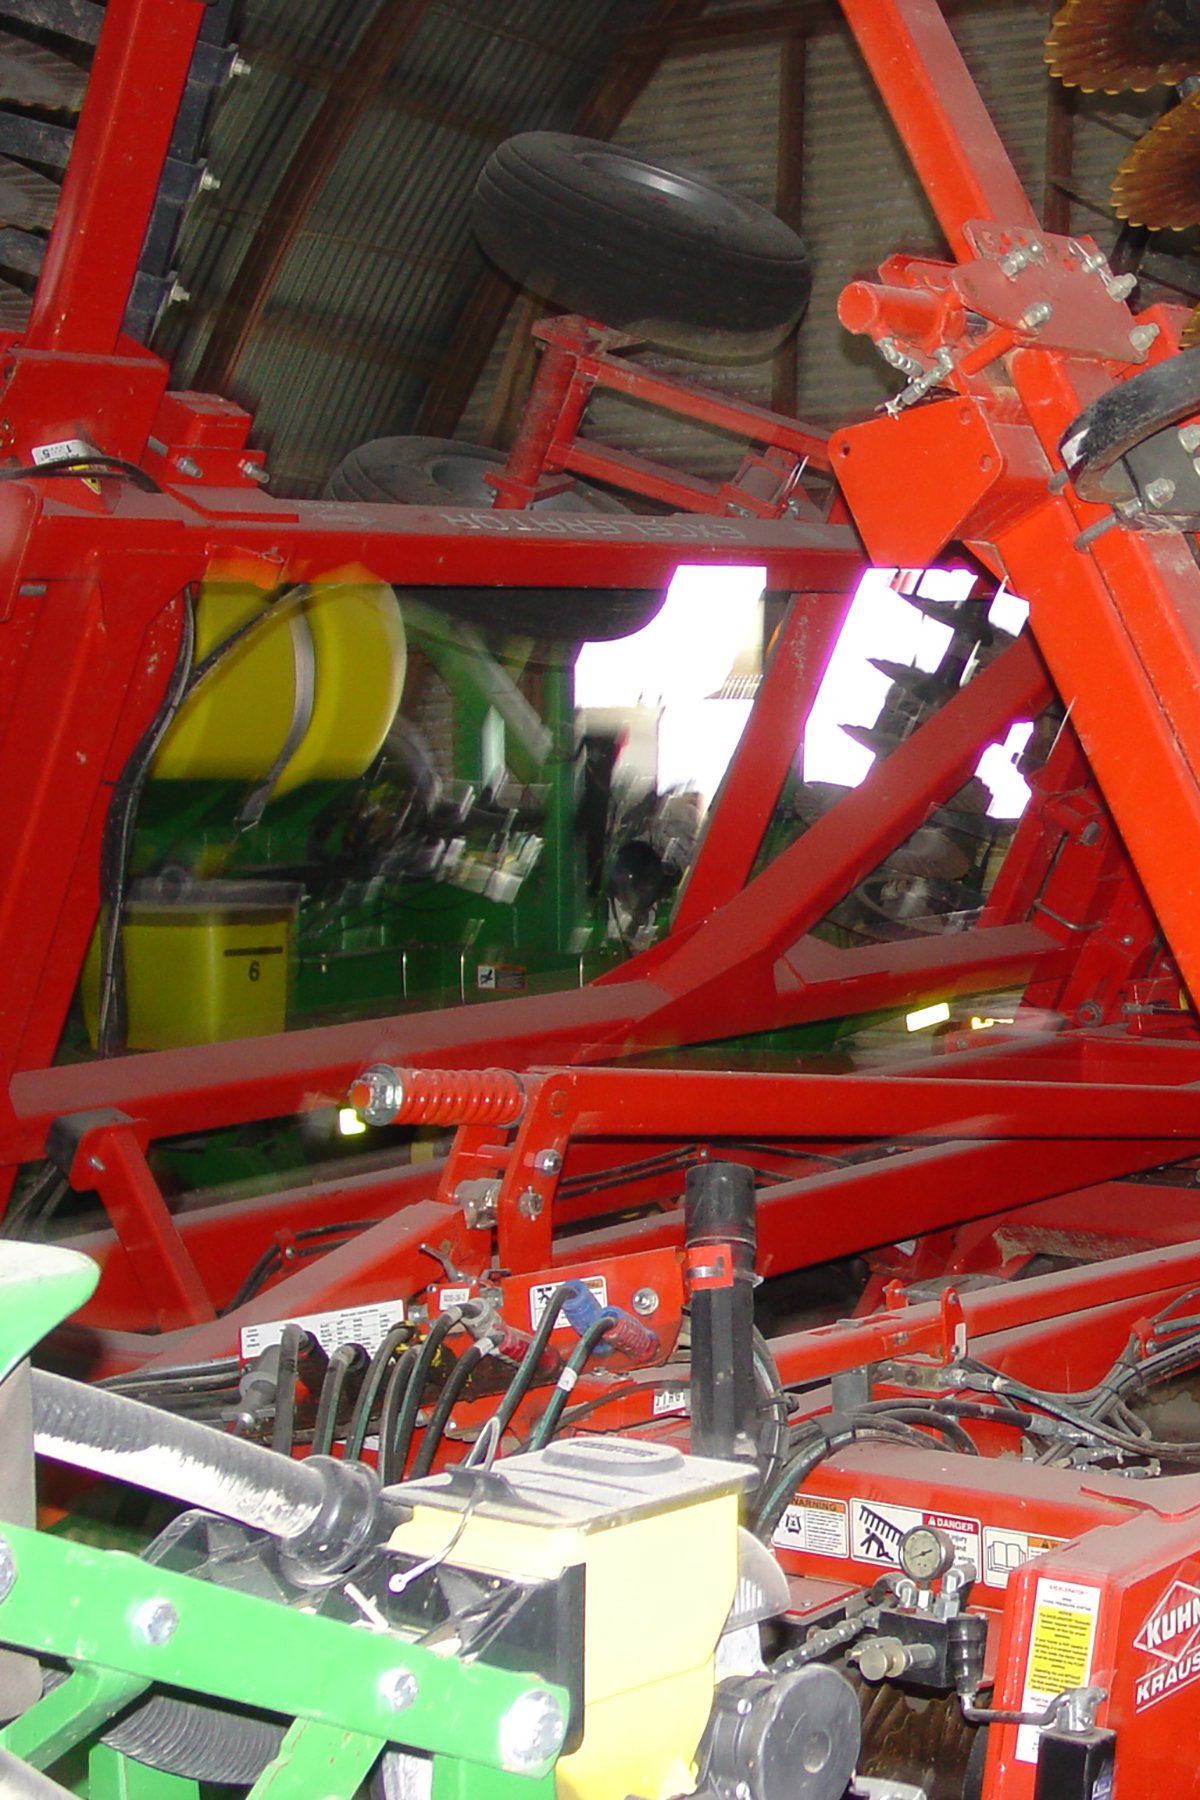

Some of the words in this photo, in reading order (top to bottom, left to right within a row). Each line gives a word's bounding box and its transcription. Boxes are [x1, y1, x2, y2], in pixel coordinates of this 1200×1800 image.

[440, 513, 746, 539] EXCELERATOR
[248, 961, 260, 982] 6
[936, 1518, 974, 1532] DANGER
